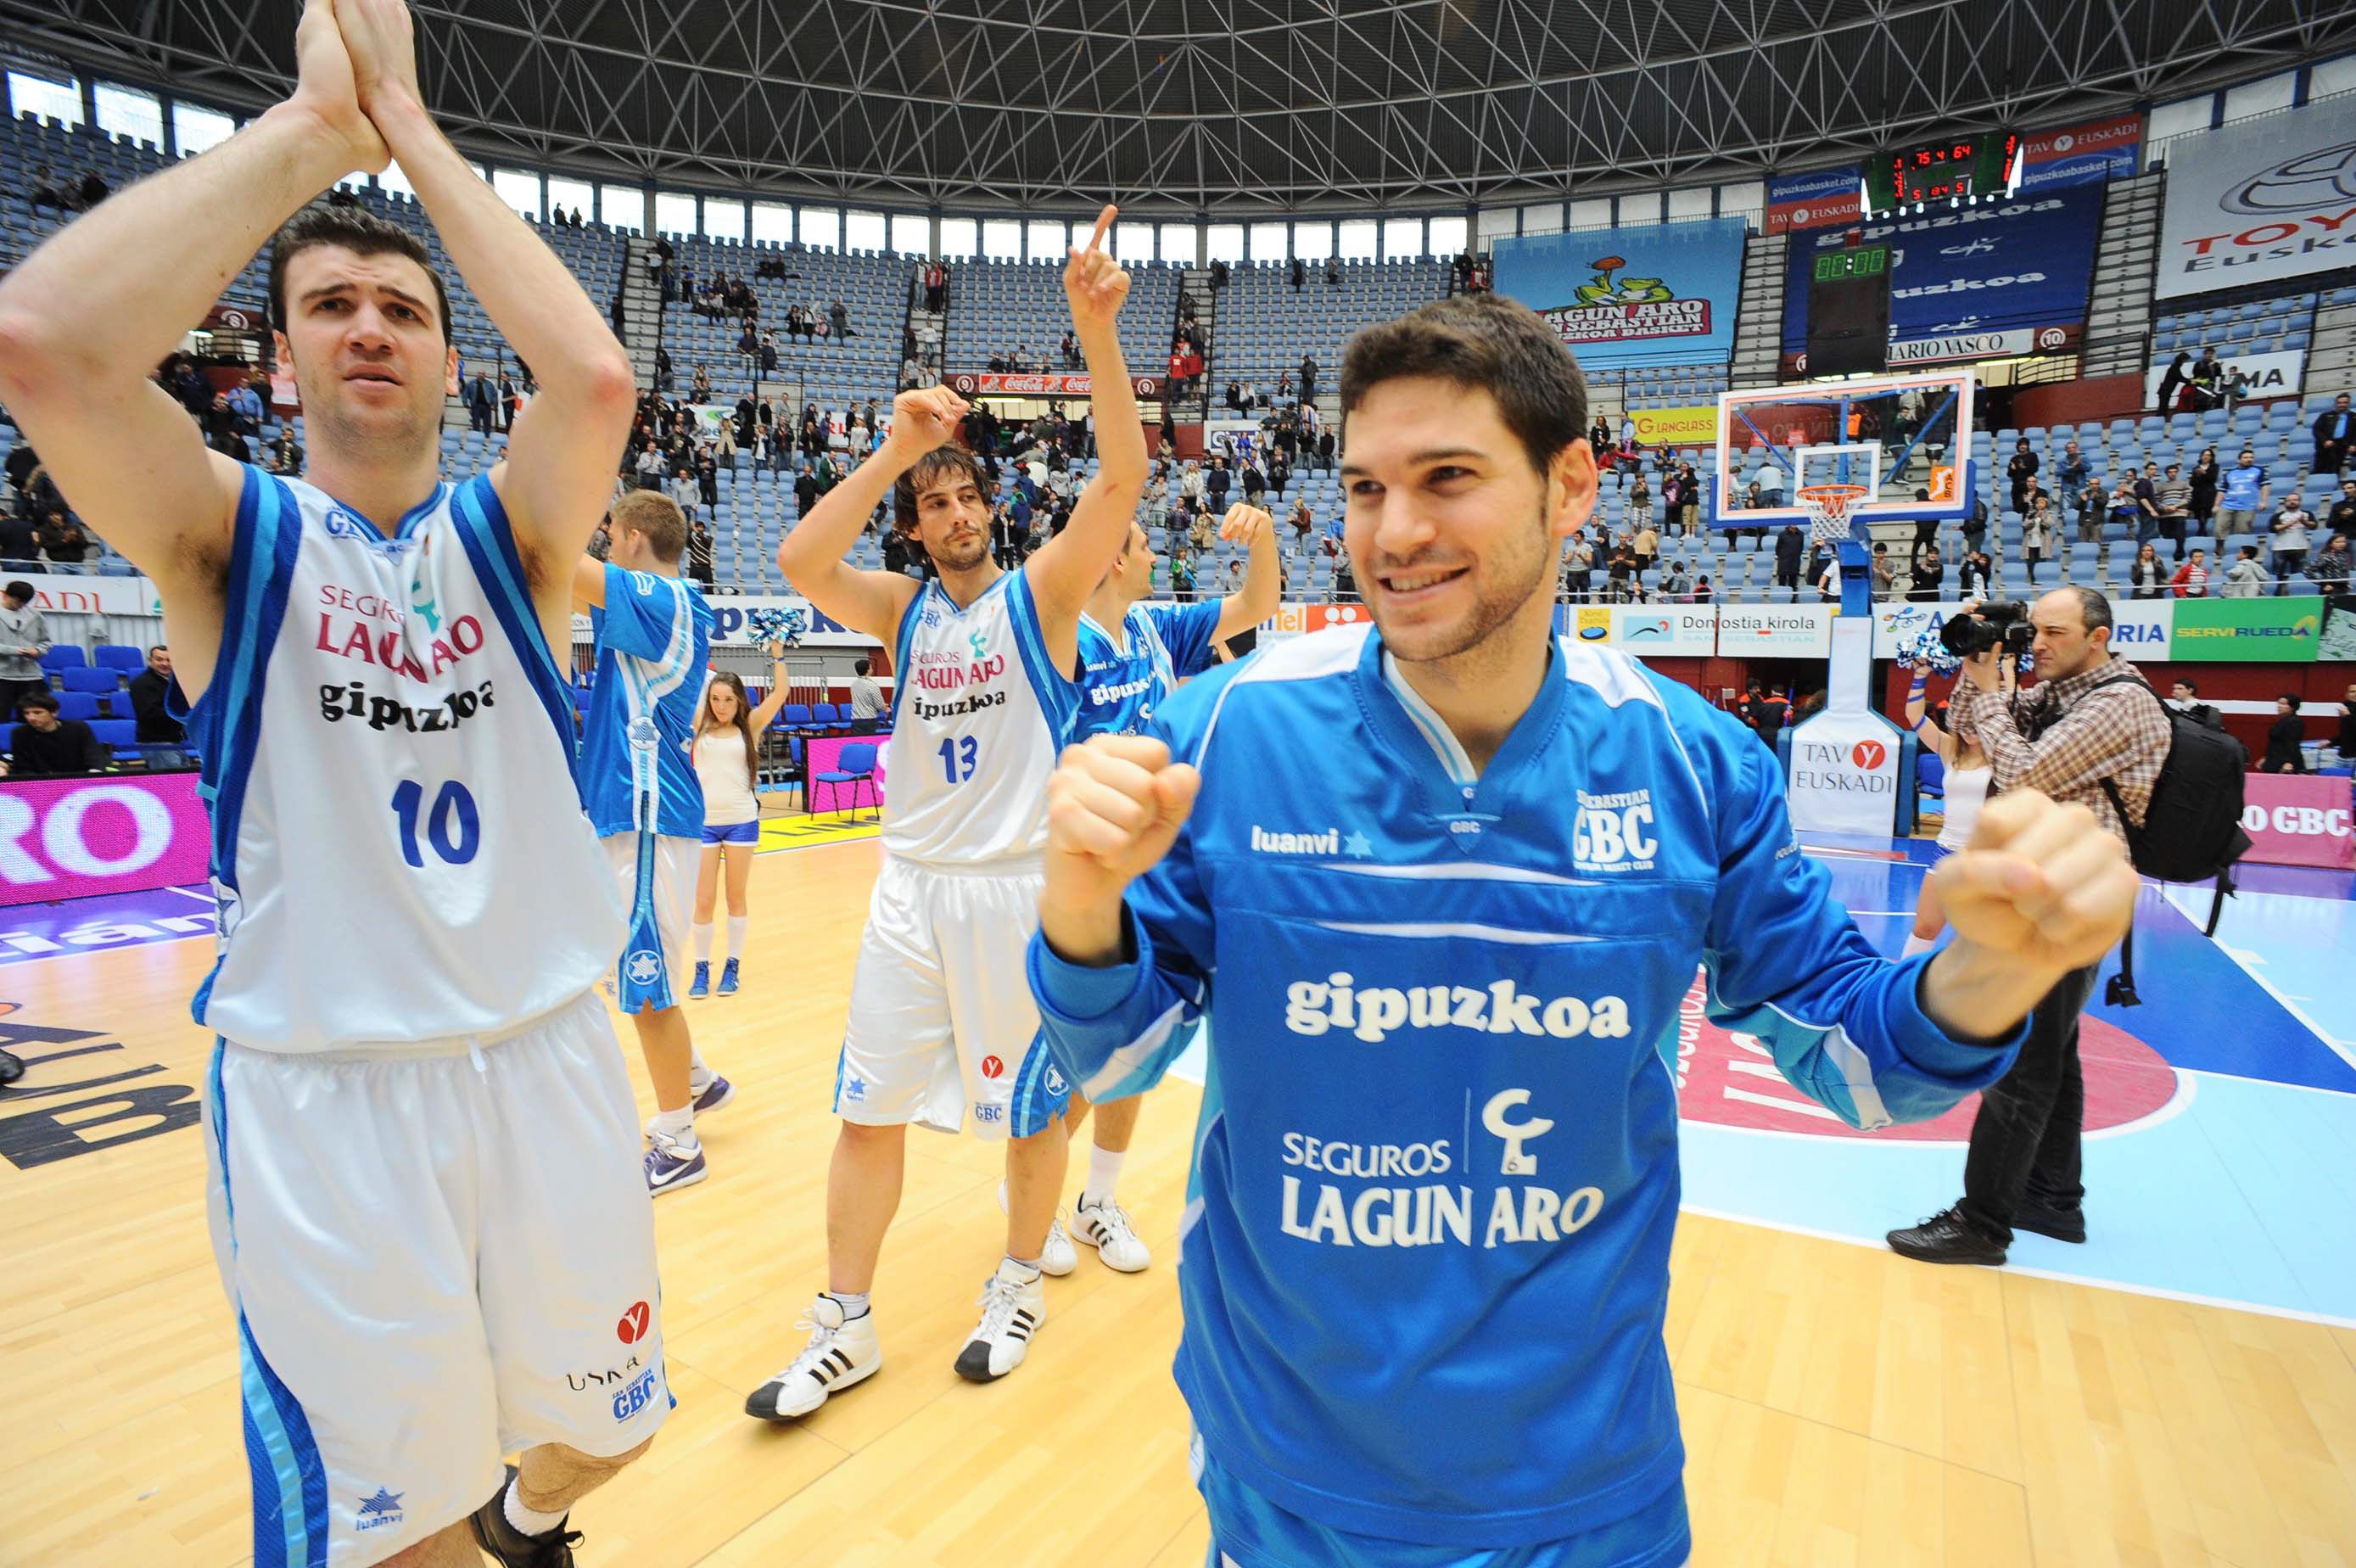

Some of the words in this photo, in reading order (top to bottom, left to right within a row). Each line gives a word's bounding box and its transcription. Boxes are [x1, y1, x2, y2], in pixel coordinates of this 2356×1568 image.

[2026, 143, 2051, 154] TAV
[2079, 123, 2138, 145] EUSKADI
[1916, 151, 1931, 165] 75
[1953, 145, 1971, 159] 64
[2024, 156, 2134, 186] gipuzkoabasket.com
[1772, 176, 1860, 198] gipuzkoabasket.com
[1771, 213, 1790, 224] TAV
[1812, 204, 1859, 218] EUSKADI
[1816, 199, 2066, 246] gpuzkoa
[2184, 234, 2356, 272] Eusk
[1893, 271, 2047, 299] uzkoa
[1542, 305, 1629, 324] AGUN
[1637, 300, 1704, 318] ARO
[1566, 312, 1702, 333] SEBASTIAN
[1556, 328, 1617, 340] ZKOA
[1621, 323, 1704, 338] BASKET
[1888, 340, 1939, 361] IARIO
[1943, 334, 2004, 355] VASCO
[960, 378, 969, 389] 9
[33, 591, 103, 614] ADI
[1767, 616, 1816, 630] kirola
[2110, 624, 2166, 643] RIA
[2176, 626, 2311, 638] SERVIRUEDA
[431, 614, 484, 676] AO
[910, 650, 961, 665] SGUROS
[911, 667, 965, 691] AGUN
[914, 691, 1006, 721] ipuzkoa
[938, 735, 979, 784] 13
[1803, 744, 1848, 763] TAV
[1795, 770, 1893, 793] EUSKADI
[391, 779, 481, 869] 10
[1573, 804, 1659, 864] GBC
[2236, 804, 2269, 832] O
[2272, 805, 2351, 837] GBC
[1251, 825, 1339, 855] luanvi
[1285, 971, 1632, 1043] gipuzkoa
[975, 1105, 1003, 1121] GBC
[1282, 1131, 1452, 1178] SEGUROS
[1280, 1174, 1474, 1248] LAGUN
[1483, 1185, 1605, 1250] ARO
[613, 1375, 656, 1420] GBC
